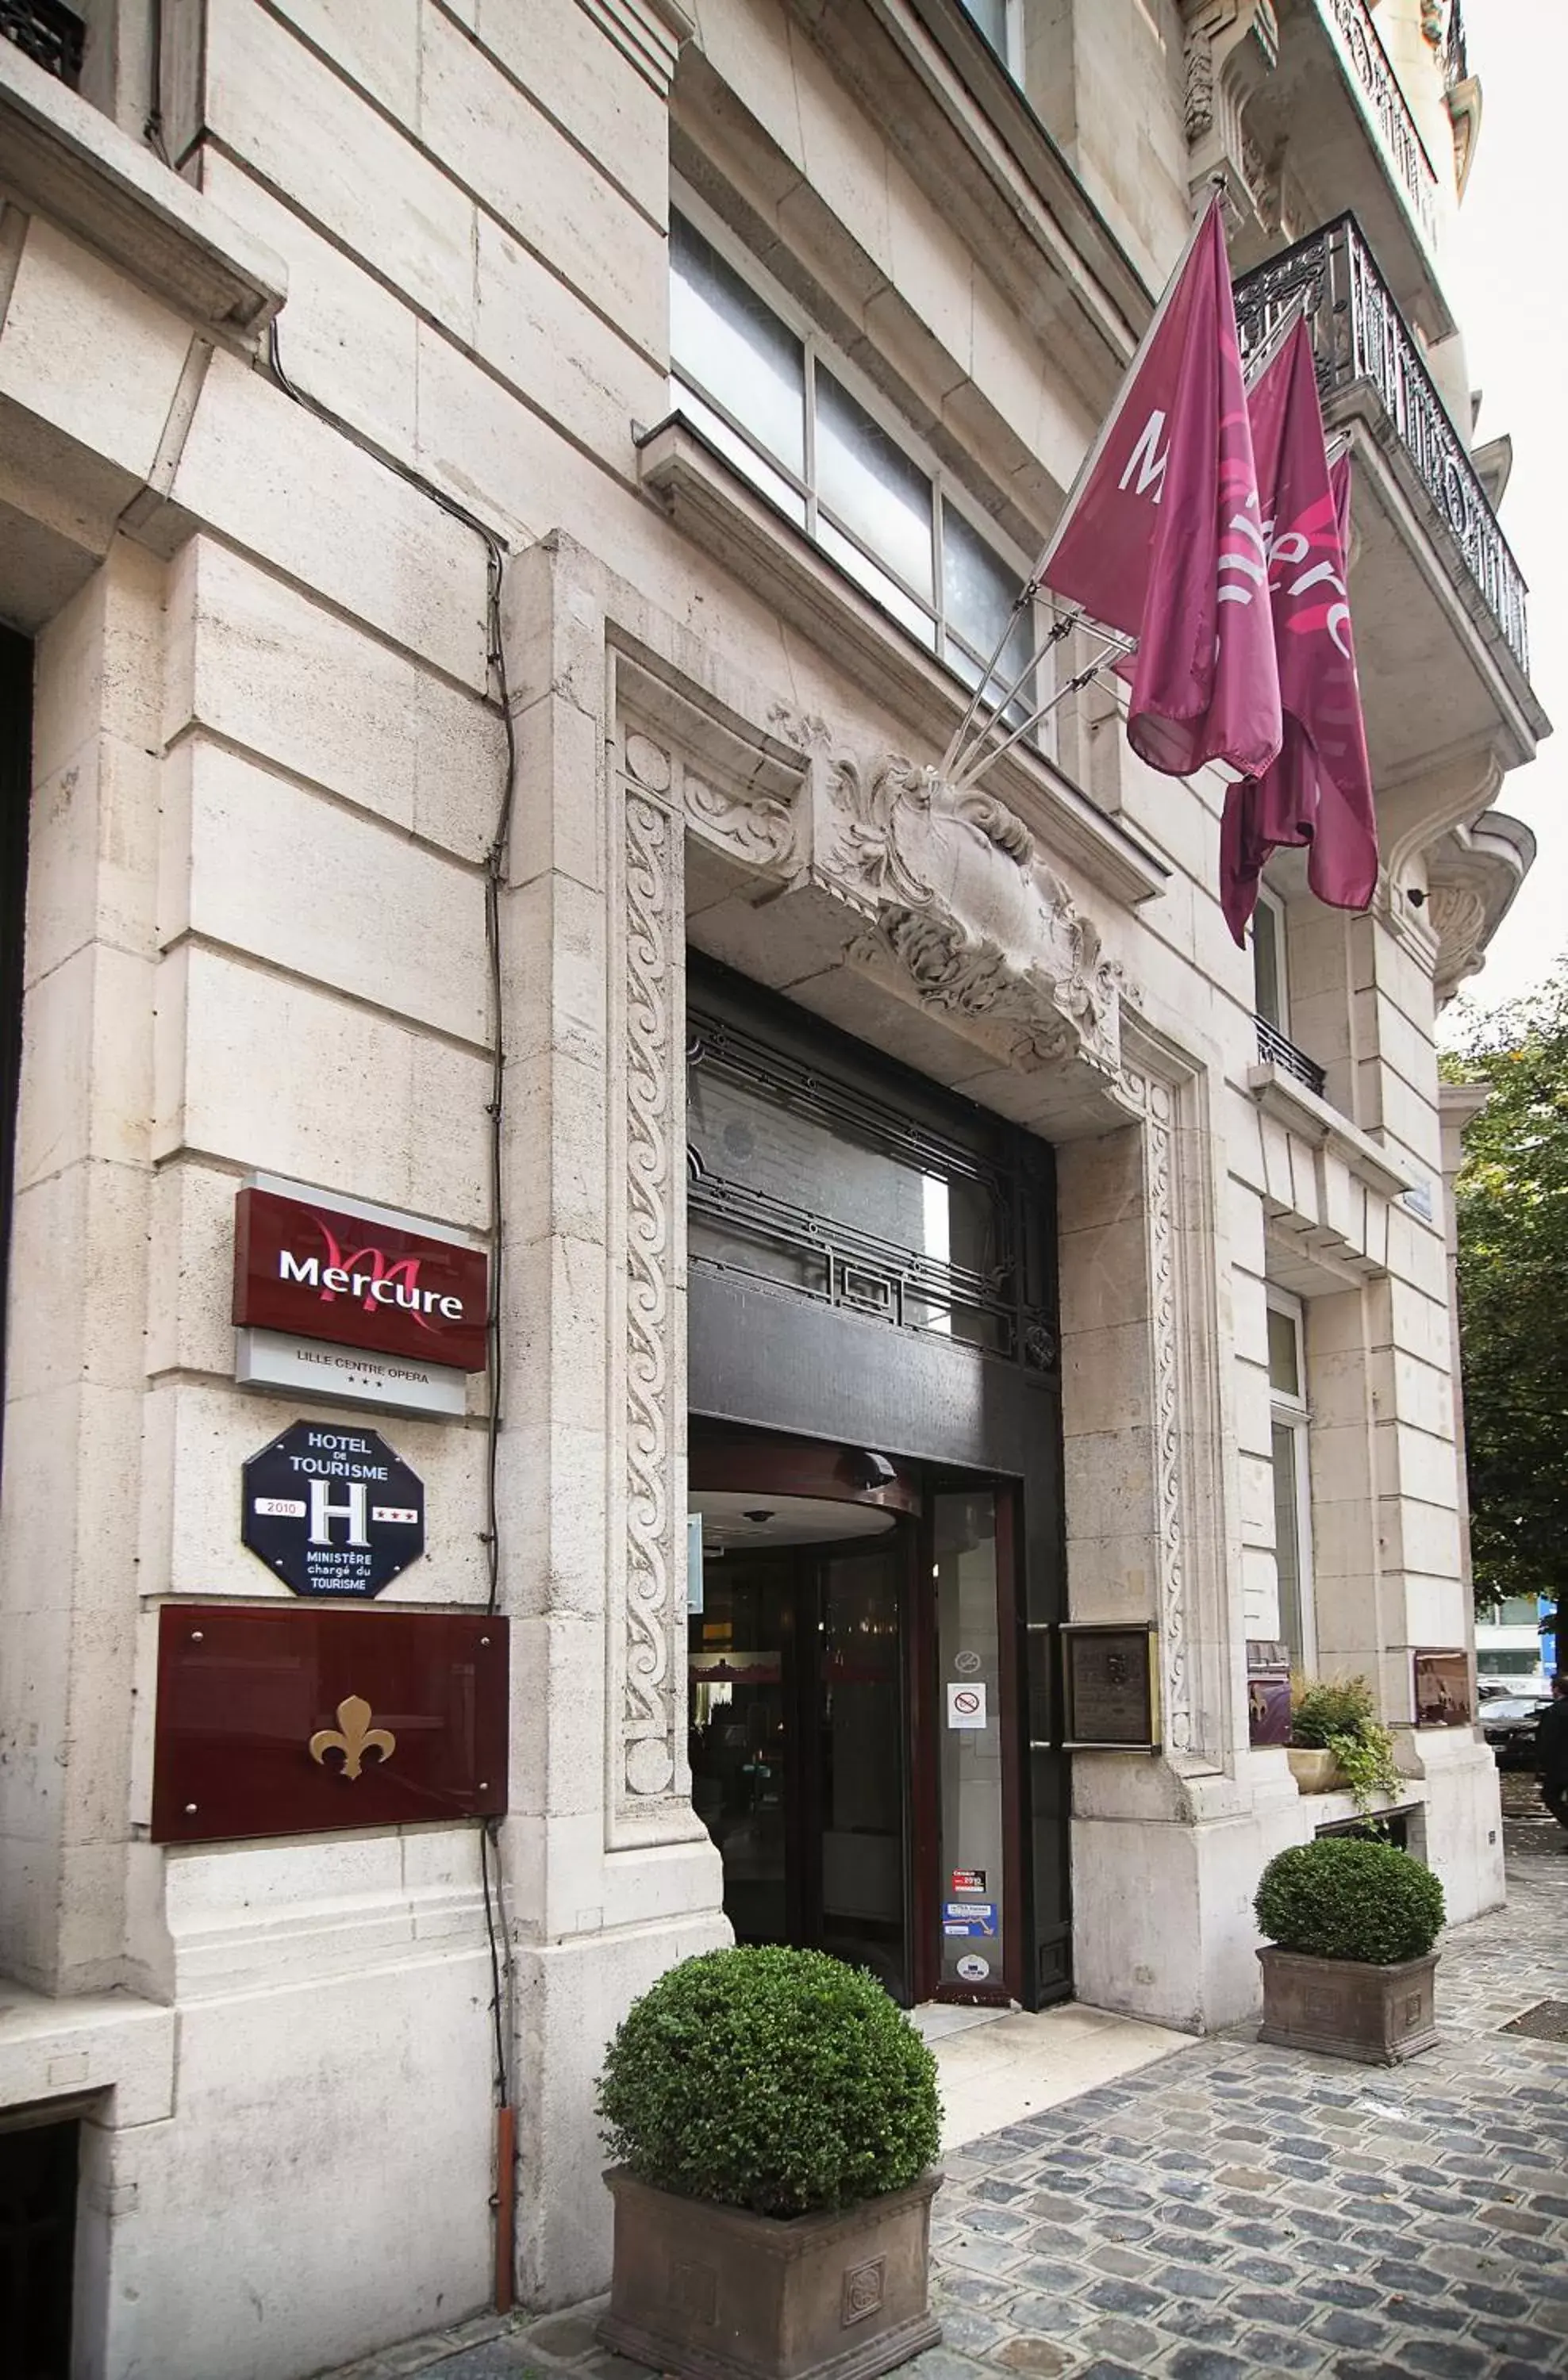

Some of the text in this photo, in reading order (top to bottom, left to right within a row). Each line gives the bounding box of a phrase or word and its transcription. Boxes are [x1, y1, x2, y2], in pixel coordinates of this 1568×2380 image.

[279, 1249, 463, 1320] Mercure
[297, 1349, 429, 1384] LILLE CENTRE OPERA
[308, 1432, 372, 1453] HOTEL
[290, 1456, 389, 1481] TOURISME
[267, 1501, 297, 1514] 2010
[307, 1478, 372, 1548] H
[356, 1566, 371, 1576] du
[310, 1578, 366, 1591] TOURISME
